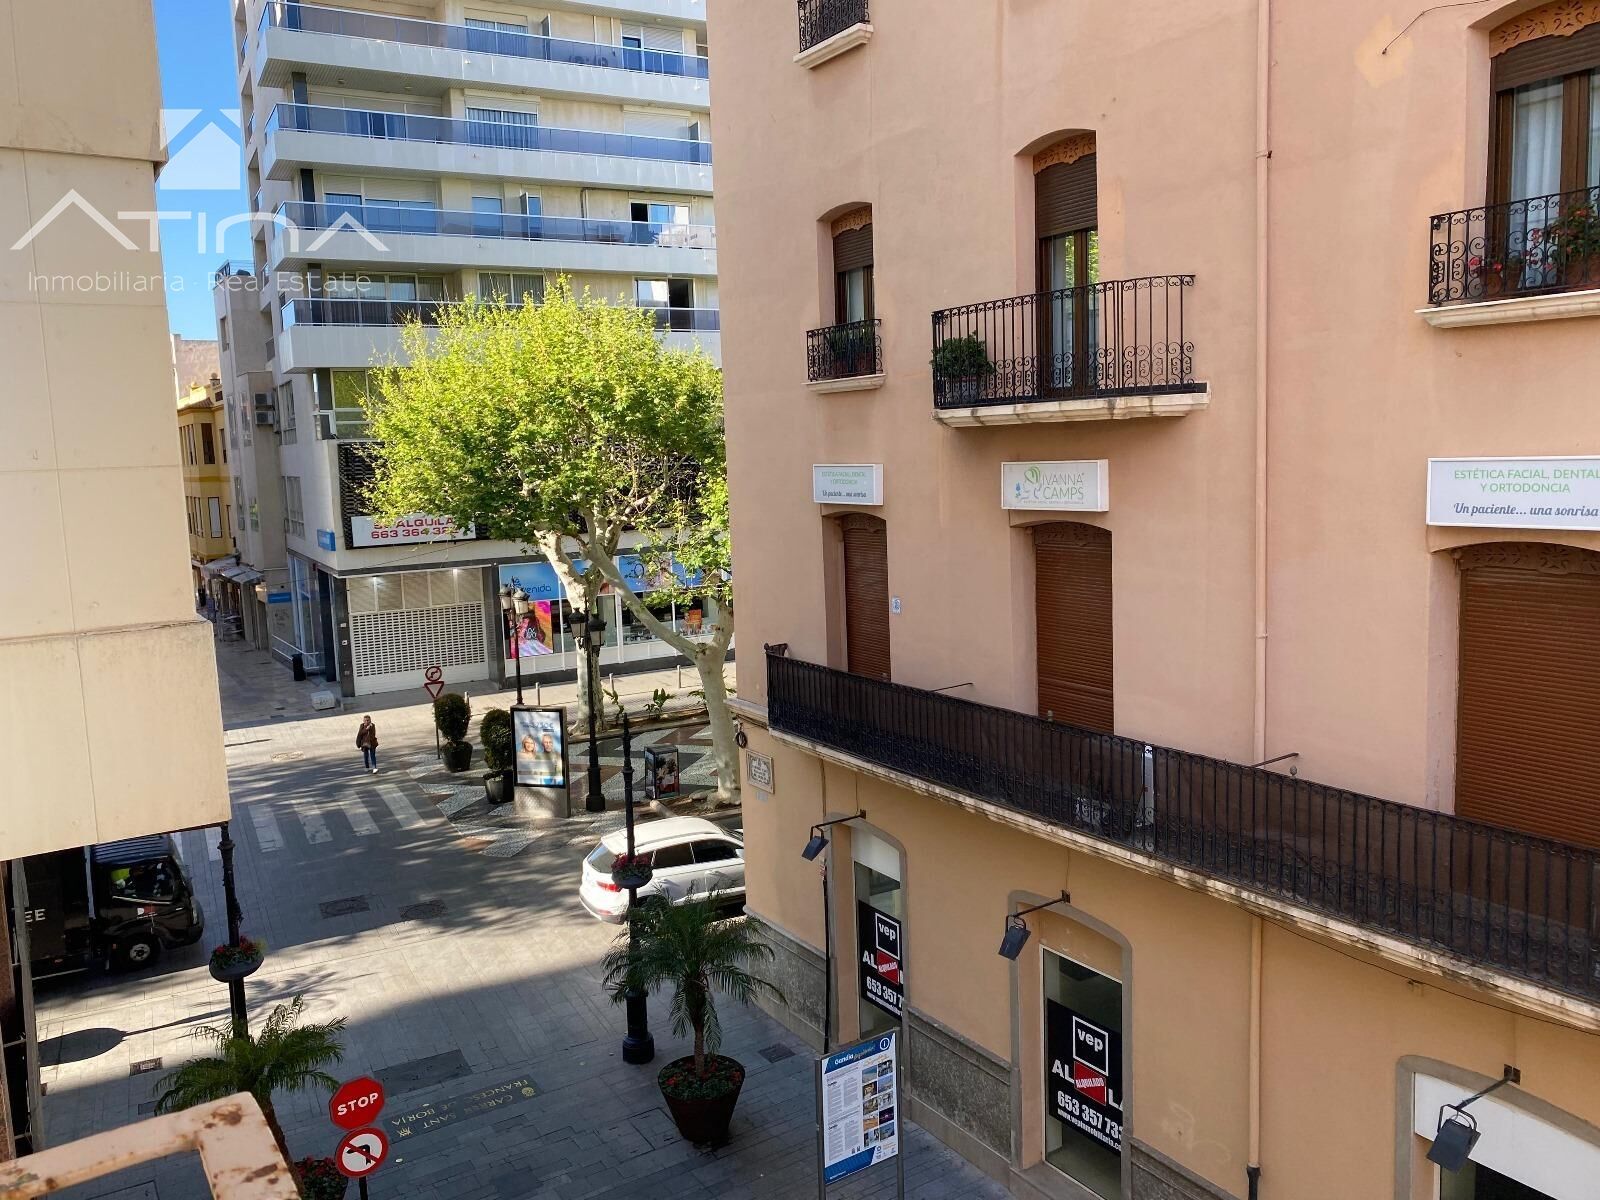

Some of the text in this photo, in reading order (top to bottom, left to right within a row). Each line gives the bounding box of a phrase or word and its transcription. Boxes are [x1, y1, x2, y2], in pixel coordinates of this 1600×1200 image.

[1042, 473, 1084, 486] IVANNA
[1454, 468, 1505, 480] ESTÉTICA
[1507, 469, 1550, 480] FACIAL,
[1043, 487, 1084, 500] CAMPS
[1480, 483, 1571, 493] Y ORTODONCIA
[1453, 502, 1599, 517] Un paciente... una sonrisa
[396, 518, 454, 529] ALQUILA
[371, 530, 398, 539] 663
[878, 922, 896, 941] vep
[866, 976, 882, 996] 653
[882, 987, 897, 1005] 357
[1077, 1028, 1104, 1052] vep
[337, 1092, 379, 1116] STOP
[1057, 1090, 1080, 1116] 653
[1081, 1104, 1103, 1130] 357
